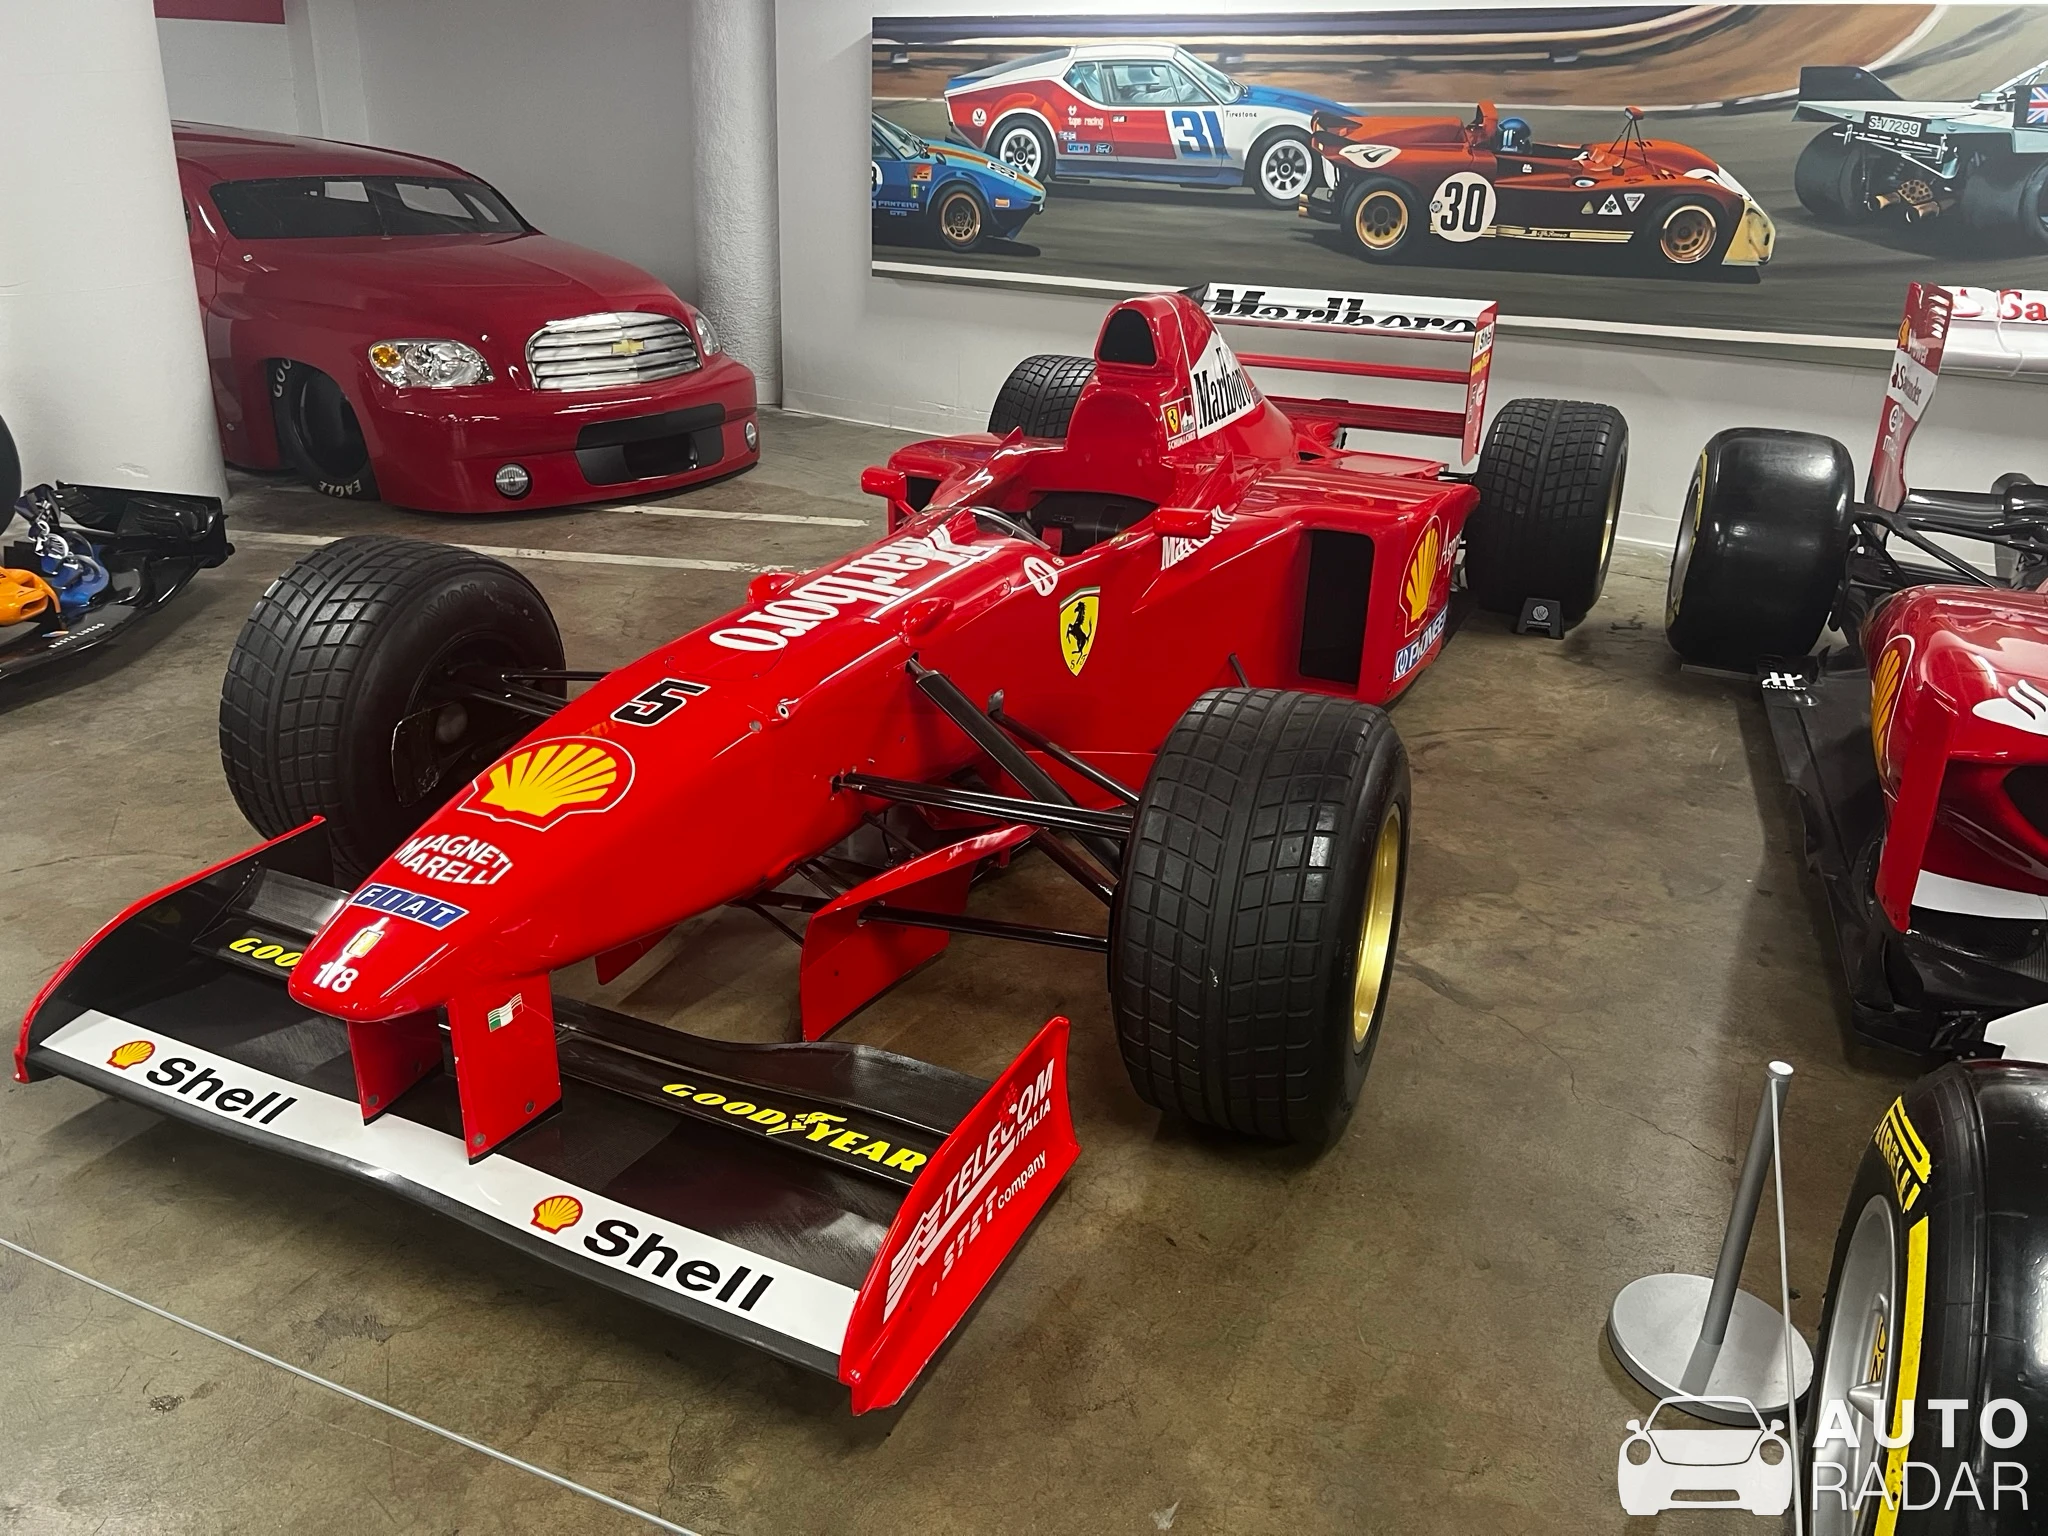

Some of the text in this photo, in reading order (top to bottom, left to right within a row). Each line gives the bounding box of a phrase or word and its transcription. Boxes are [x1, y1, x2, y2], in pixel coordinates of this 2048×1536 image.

[1171, 111, 1232, 160] 31
[1889, 120, 1919, 136] 7299
[1440, 182, 1487, 232] 30
[1208, 289, 1477, 332] Marlboro
[319, 479, 362, 498] EAGLE
[709, 524, 994, 651] Marlboro
[610, 677, 711, 727] 5
[357, 886, 456, 922] FIAT
[145, 1057, 298, 1125] Shell
[944, 1057, 1055, 1216] TELECOM
[1014, 1098, 1051, 1149] ITALIA
[942, 1186, 998, 1281] STET
[997, 1150, 1047, 1209] company
[583, 1219, 774, 1311] Shell
